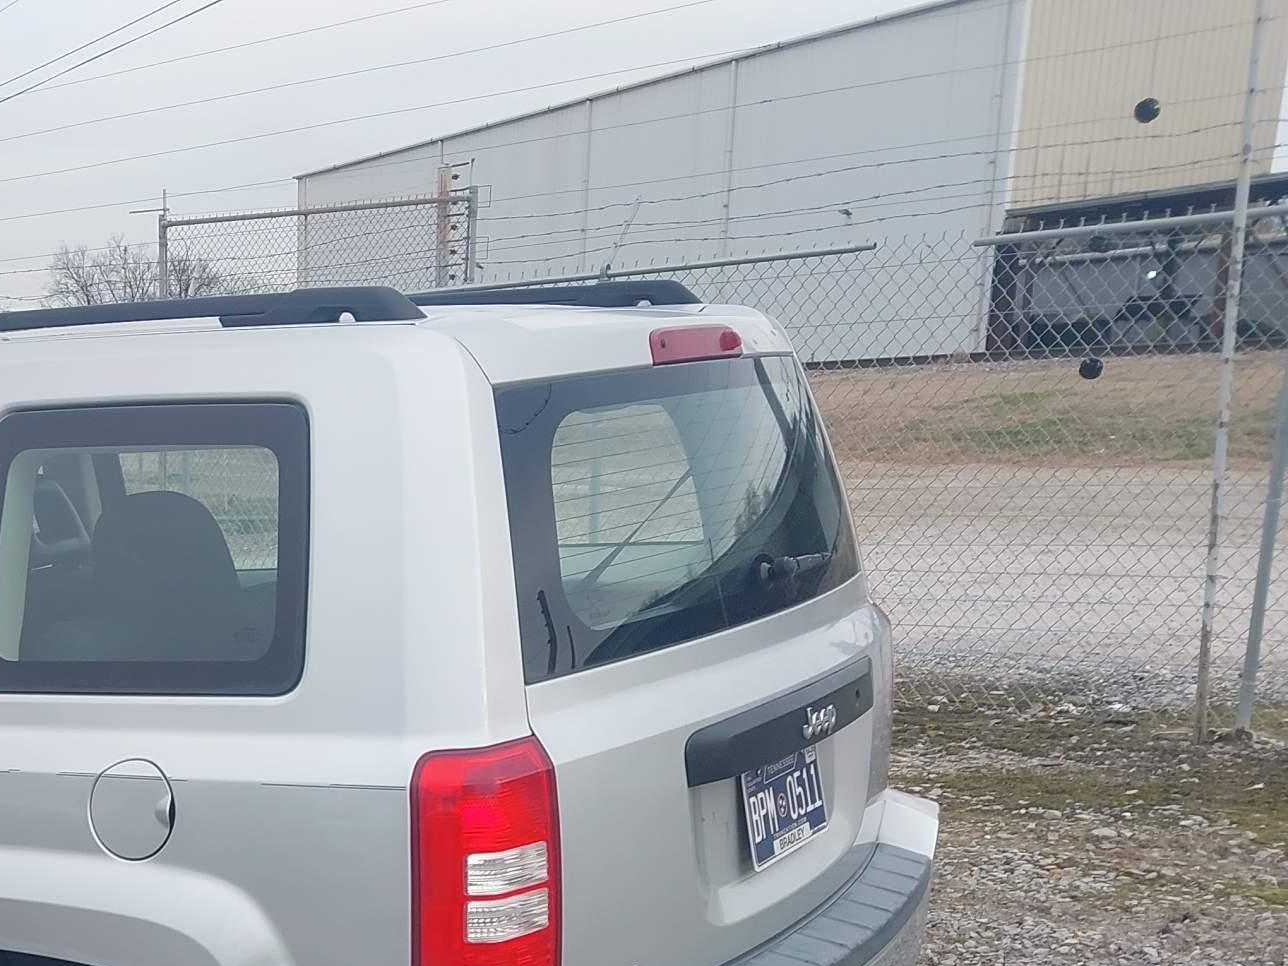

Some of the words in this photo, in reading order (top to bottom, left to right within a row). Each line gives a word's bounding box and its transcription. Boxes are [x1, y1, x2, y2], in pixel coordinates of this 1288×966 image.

[802, 704, 837, 740] Jeep
[749, 786, 779, 843] BPM
[786, 763, 823, 820] 0511
[779, 828, 805, 850] BRADLEY
